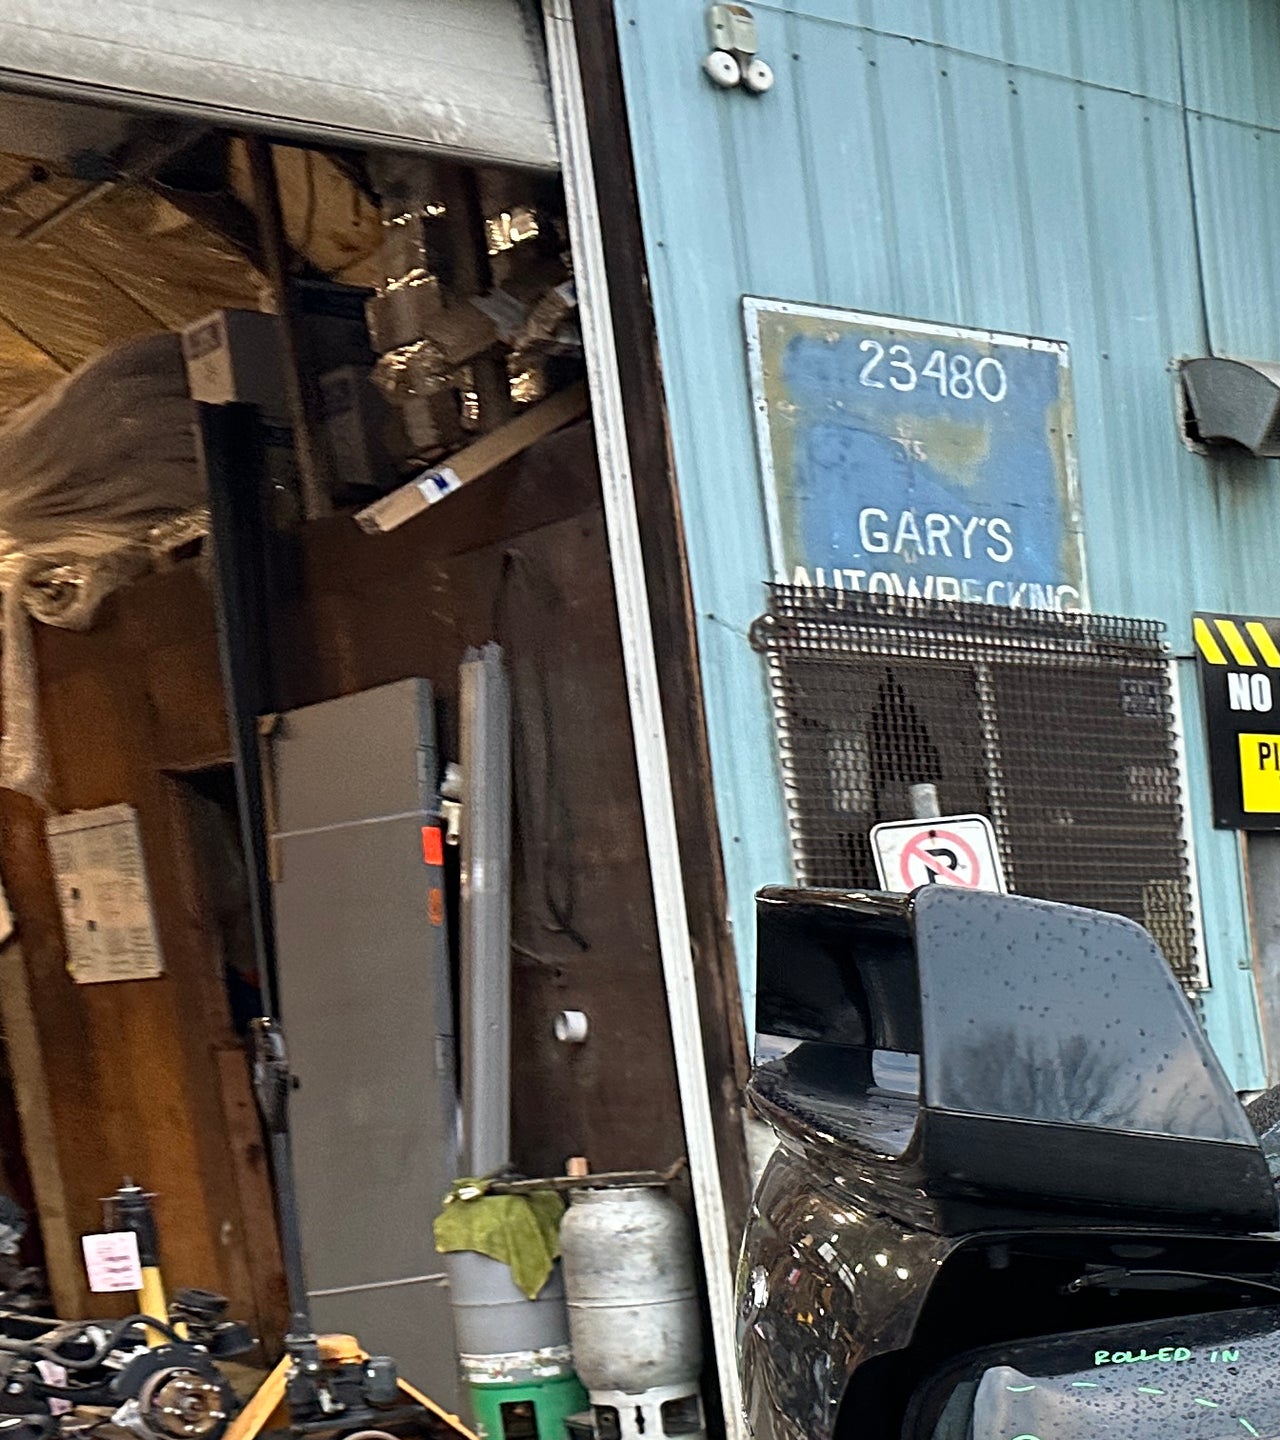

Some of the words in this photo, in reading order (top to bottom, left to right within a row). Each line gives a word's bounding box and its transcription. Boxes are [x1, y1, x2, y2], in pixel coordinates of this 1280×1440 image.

[859, 340, 1007, 402] 23480
[858, 507, 1014, 562] GARY'S
[1227, 672, 1272, 712] NO
[1094, 1347, 1191, 1365] ROLLED
[1210, 1350, 1240, 1363] IN
